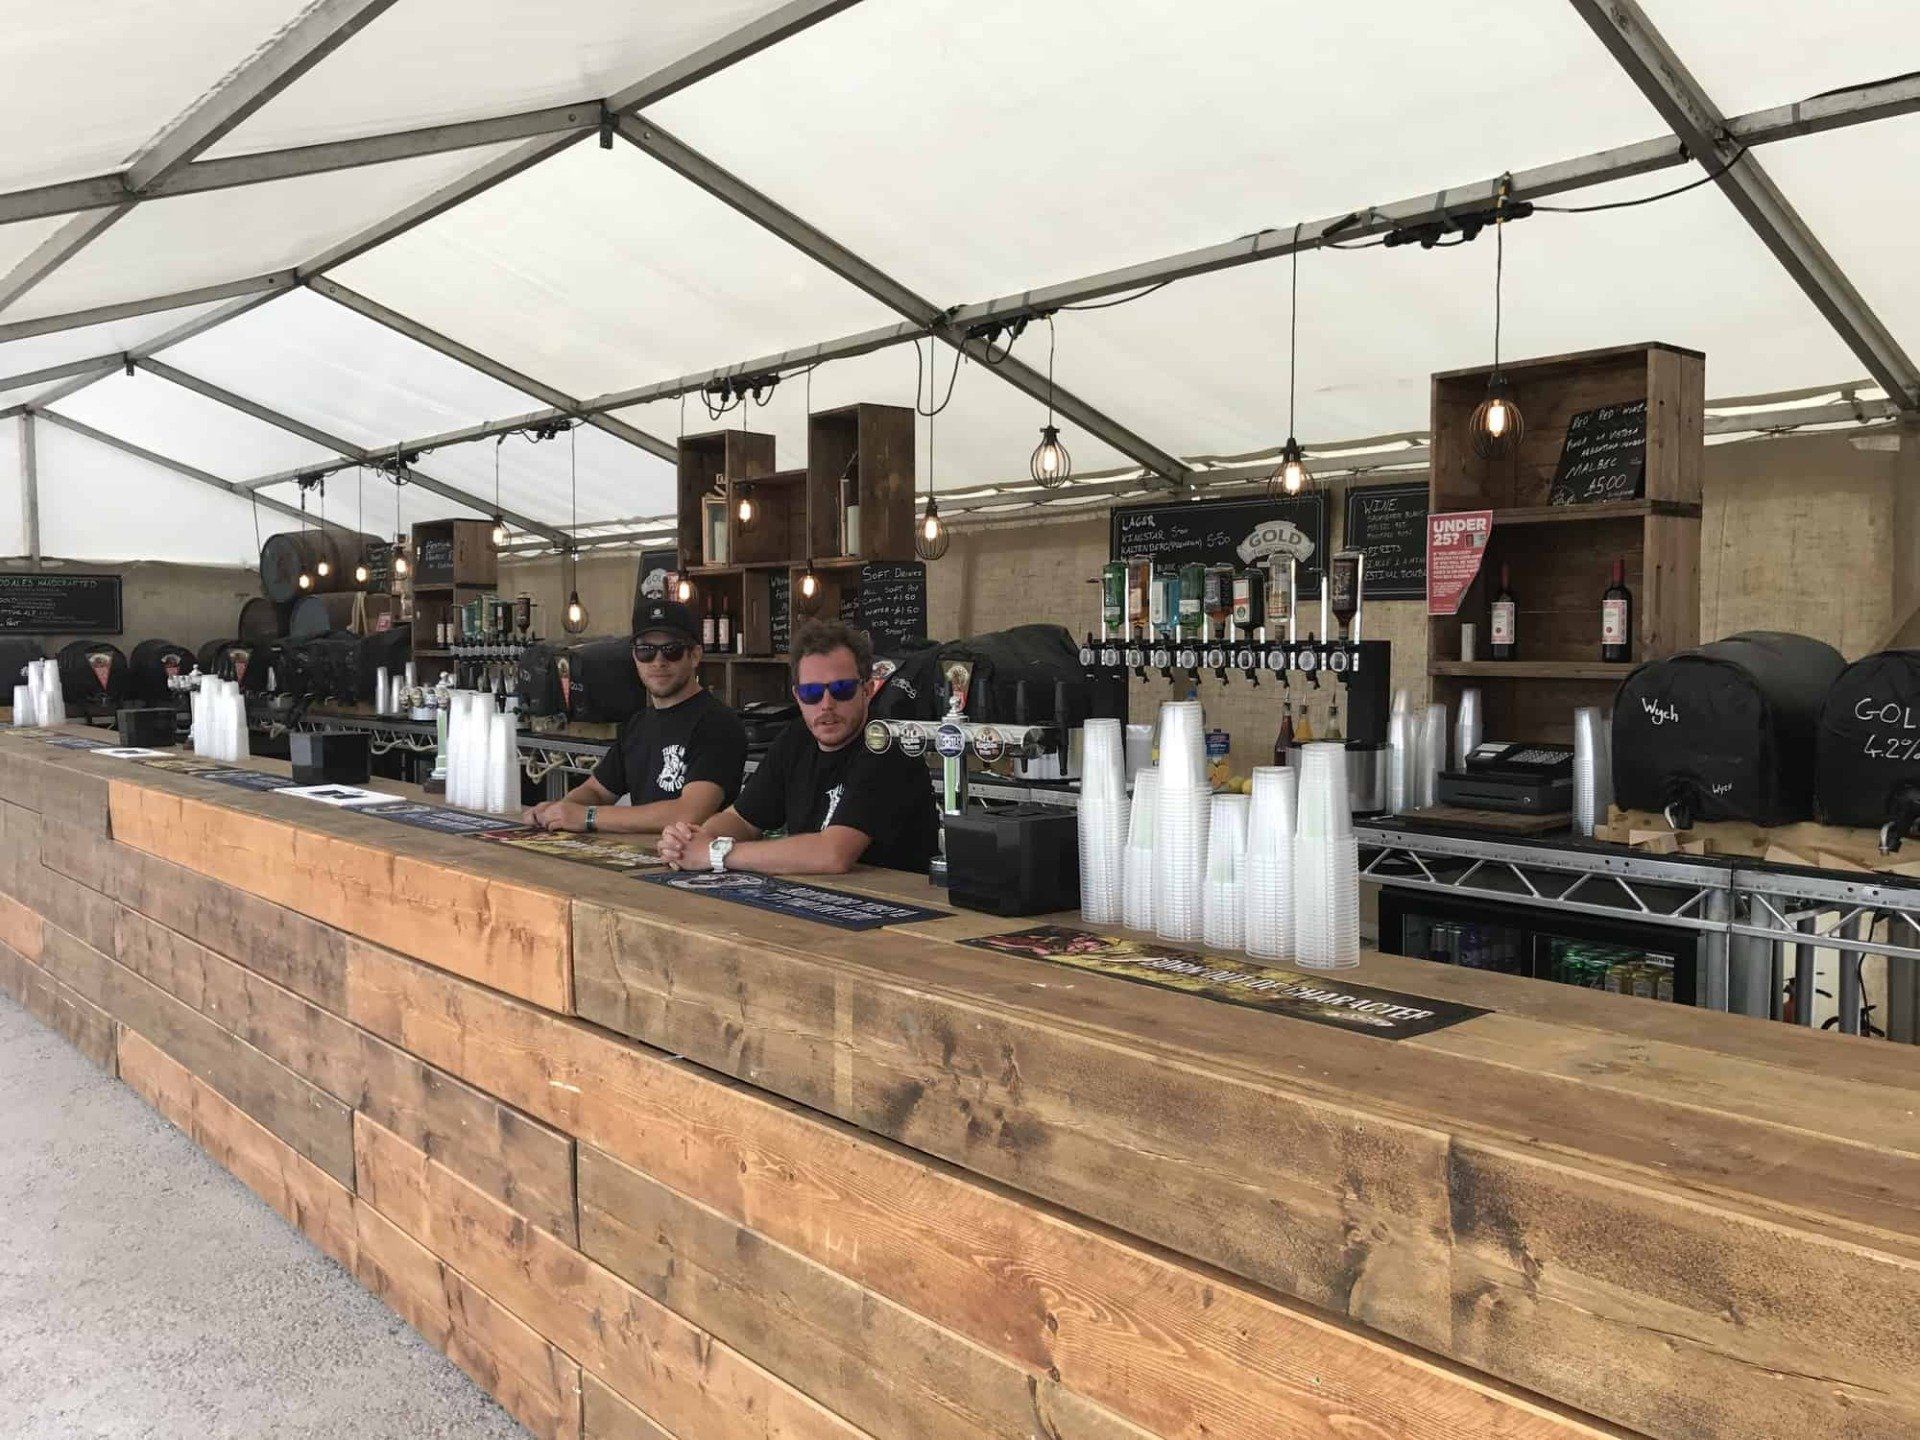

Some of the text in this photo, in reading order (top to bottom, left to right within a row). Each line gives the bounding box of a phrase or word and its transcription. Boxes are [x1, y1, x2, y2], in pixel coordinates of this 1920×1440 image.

[1565, 457, 1618, 479] MALBEC
[1362, 498, 1397, 514] WINE
[1122, 515, 1156, 531] LAGER
[1433, 518, 1487, 533] UNDER
[1249, 529, 1302, 549] GOLD
[1433, 533, 1460, 546] 25?
[862, 566, 890, 581] SOFT
[1641, 697, 1680, 725] Wych
[1864, 734, 1920, 761] 4.2%
[1200, 969, 1253, 983] OUT
[1247, 979, 1286, 991] OF
[1281, 985, 1437, 1021] CHARACTER
